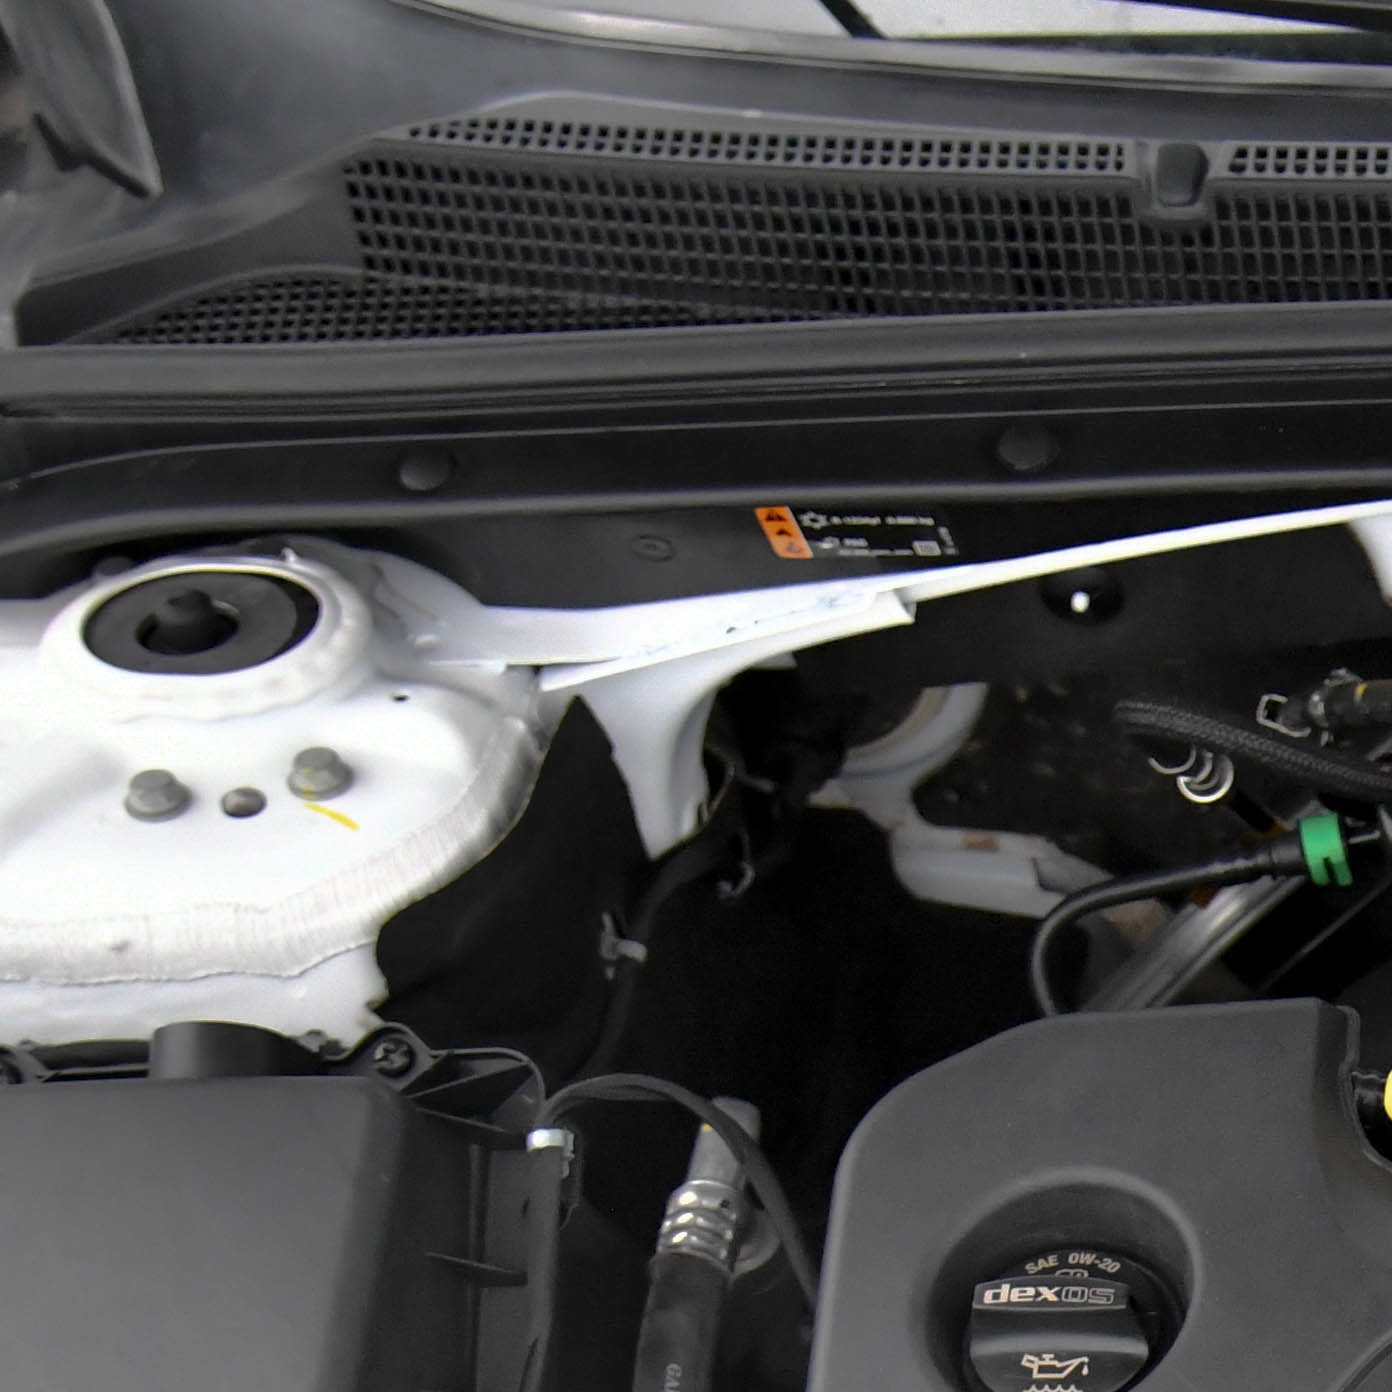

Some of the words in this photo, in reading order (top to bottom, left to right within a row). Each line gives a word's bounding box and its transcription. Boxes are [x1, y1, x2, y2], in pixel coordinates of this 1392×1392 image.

[1025, 1254, 1059, 1274] SAE
[1067, 1252, 1121, 1273] 0W-20
[983, 1284, 1116, 1305] dexos
